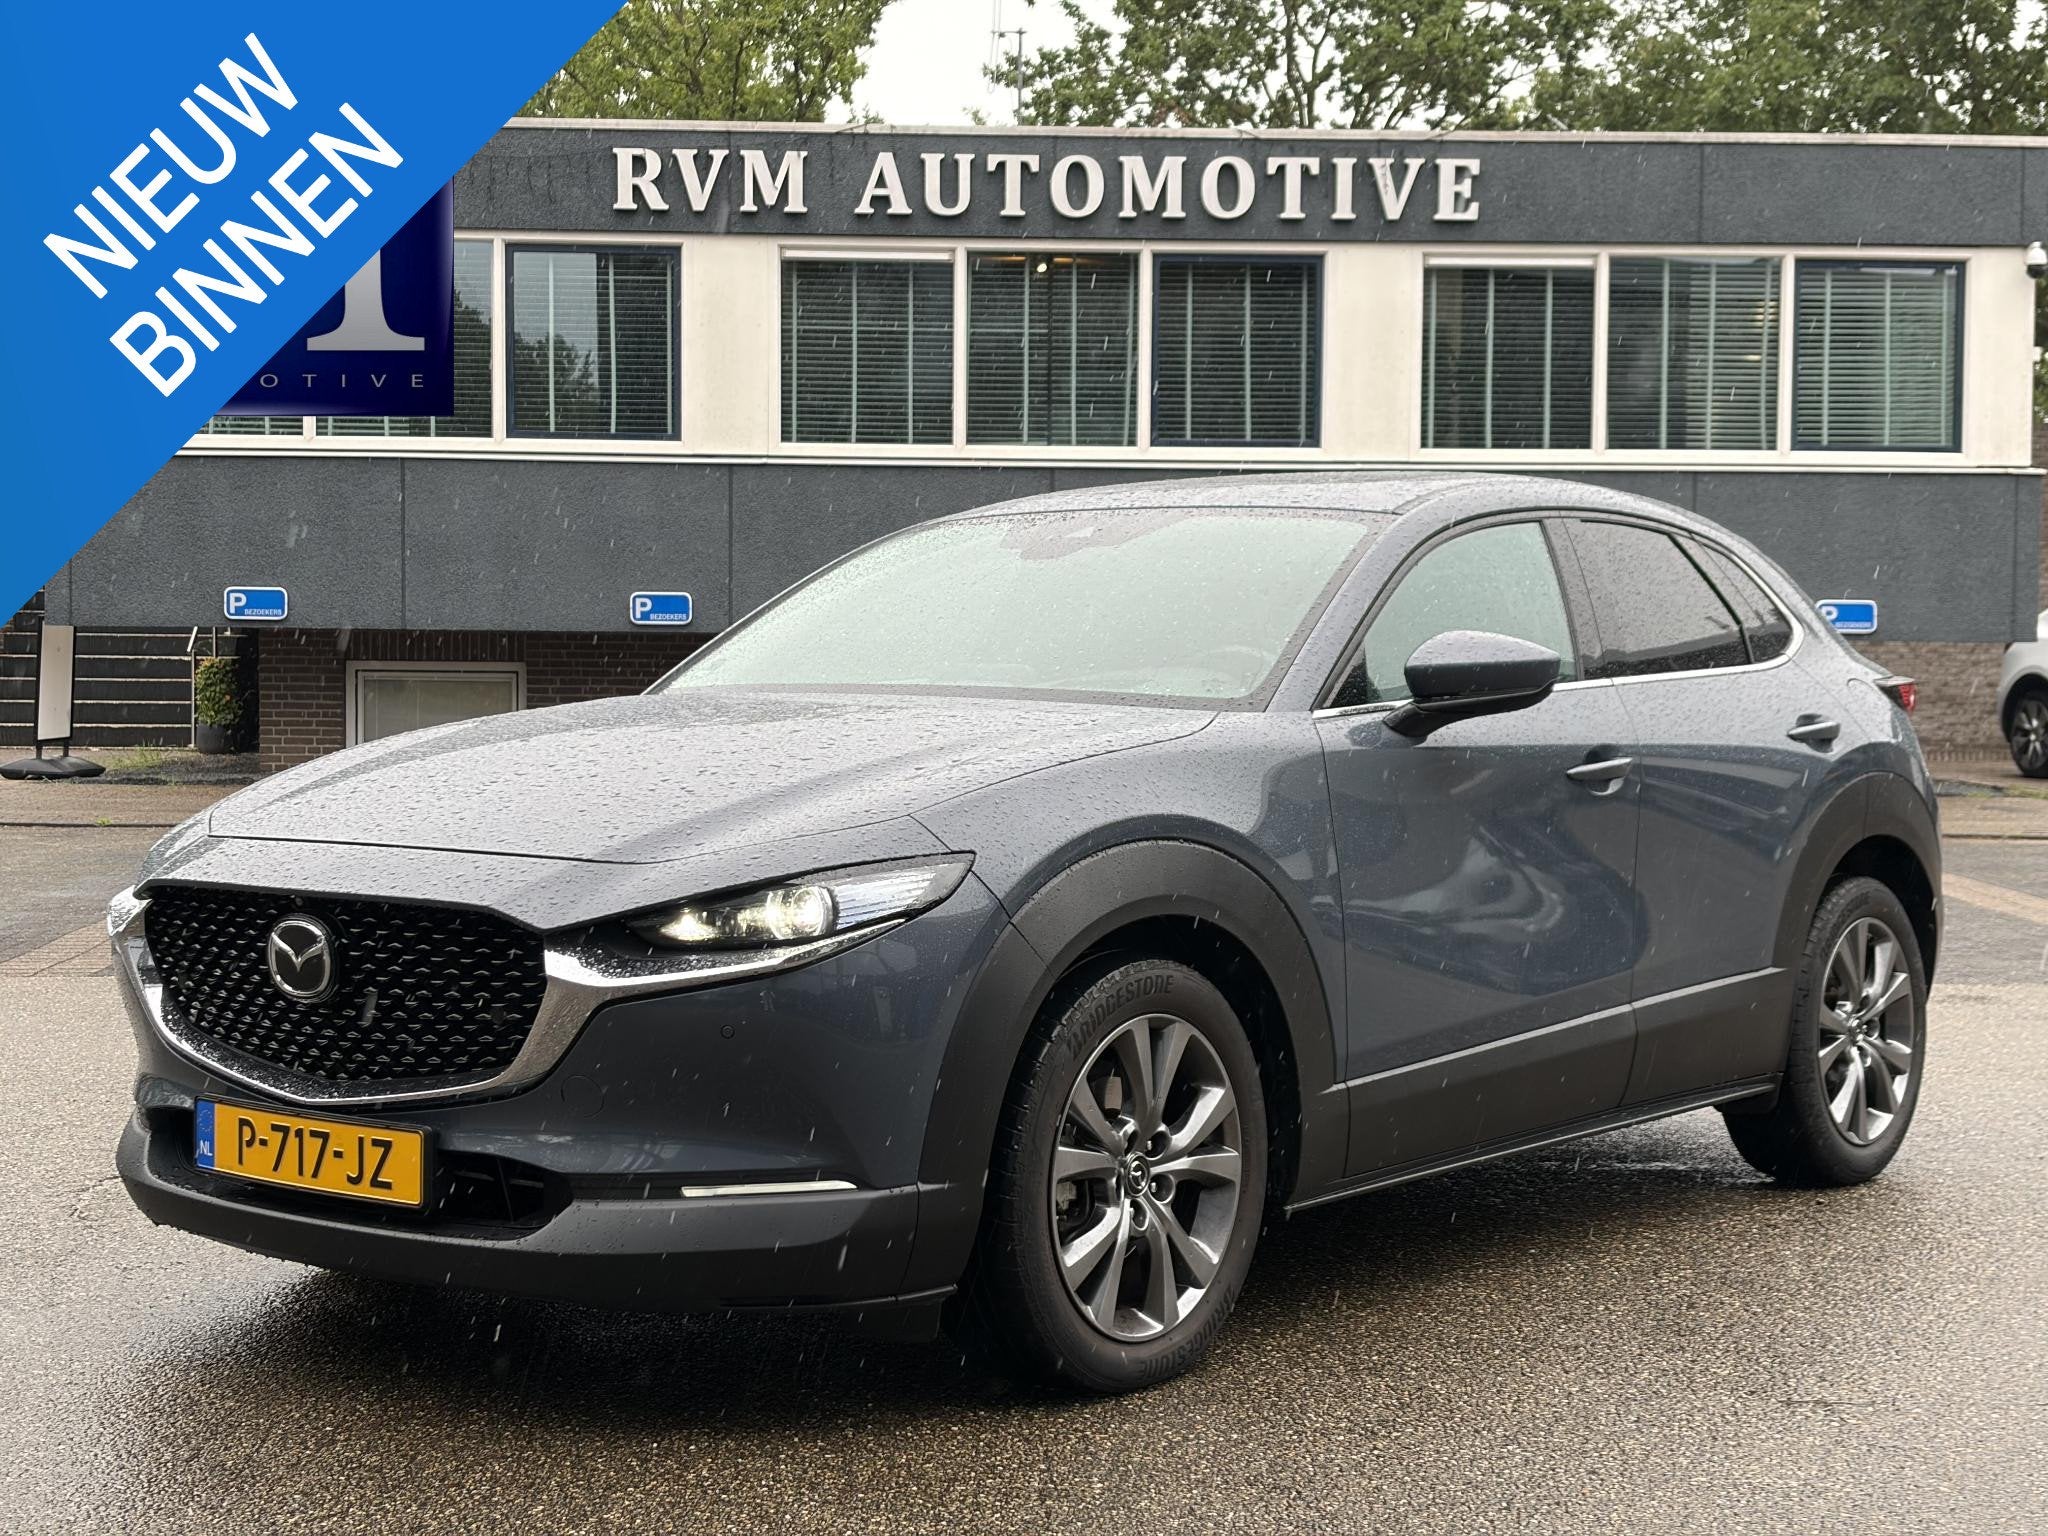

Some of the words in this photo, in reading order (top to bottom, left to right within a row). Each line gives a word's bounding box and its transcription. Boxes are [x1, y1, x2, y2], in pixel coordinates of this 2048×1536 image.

[612, 147, 808, 212] RVM
[854, 151, 1481, 221] AUTOMOTIVE
[229, 592, 247, 614] P
[244, 608, 282, 616] BEZOEKERS
[635, 597, 653, 619] P
[200, 1139, 214, 1157] NL
[237, 1116, 393, 1190] P-717-JZ
